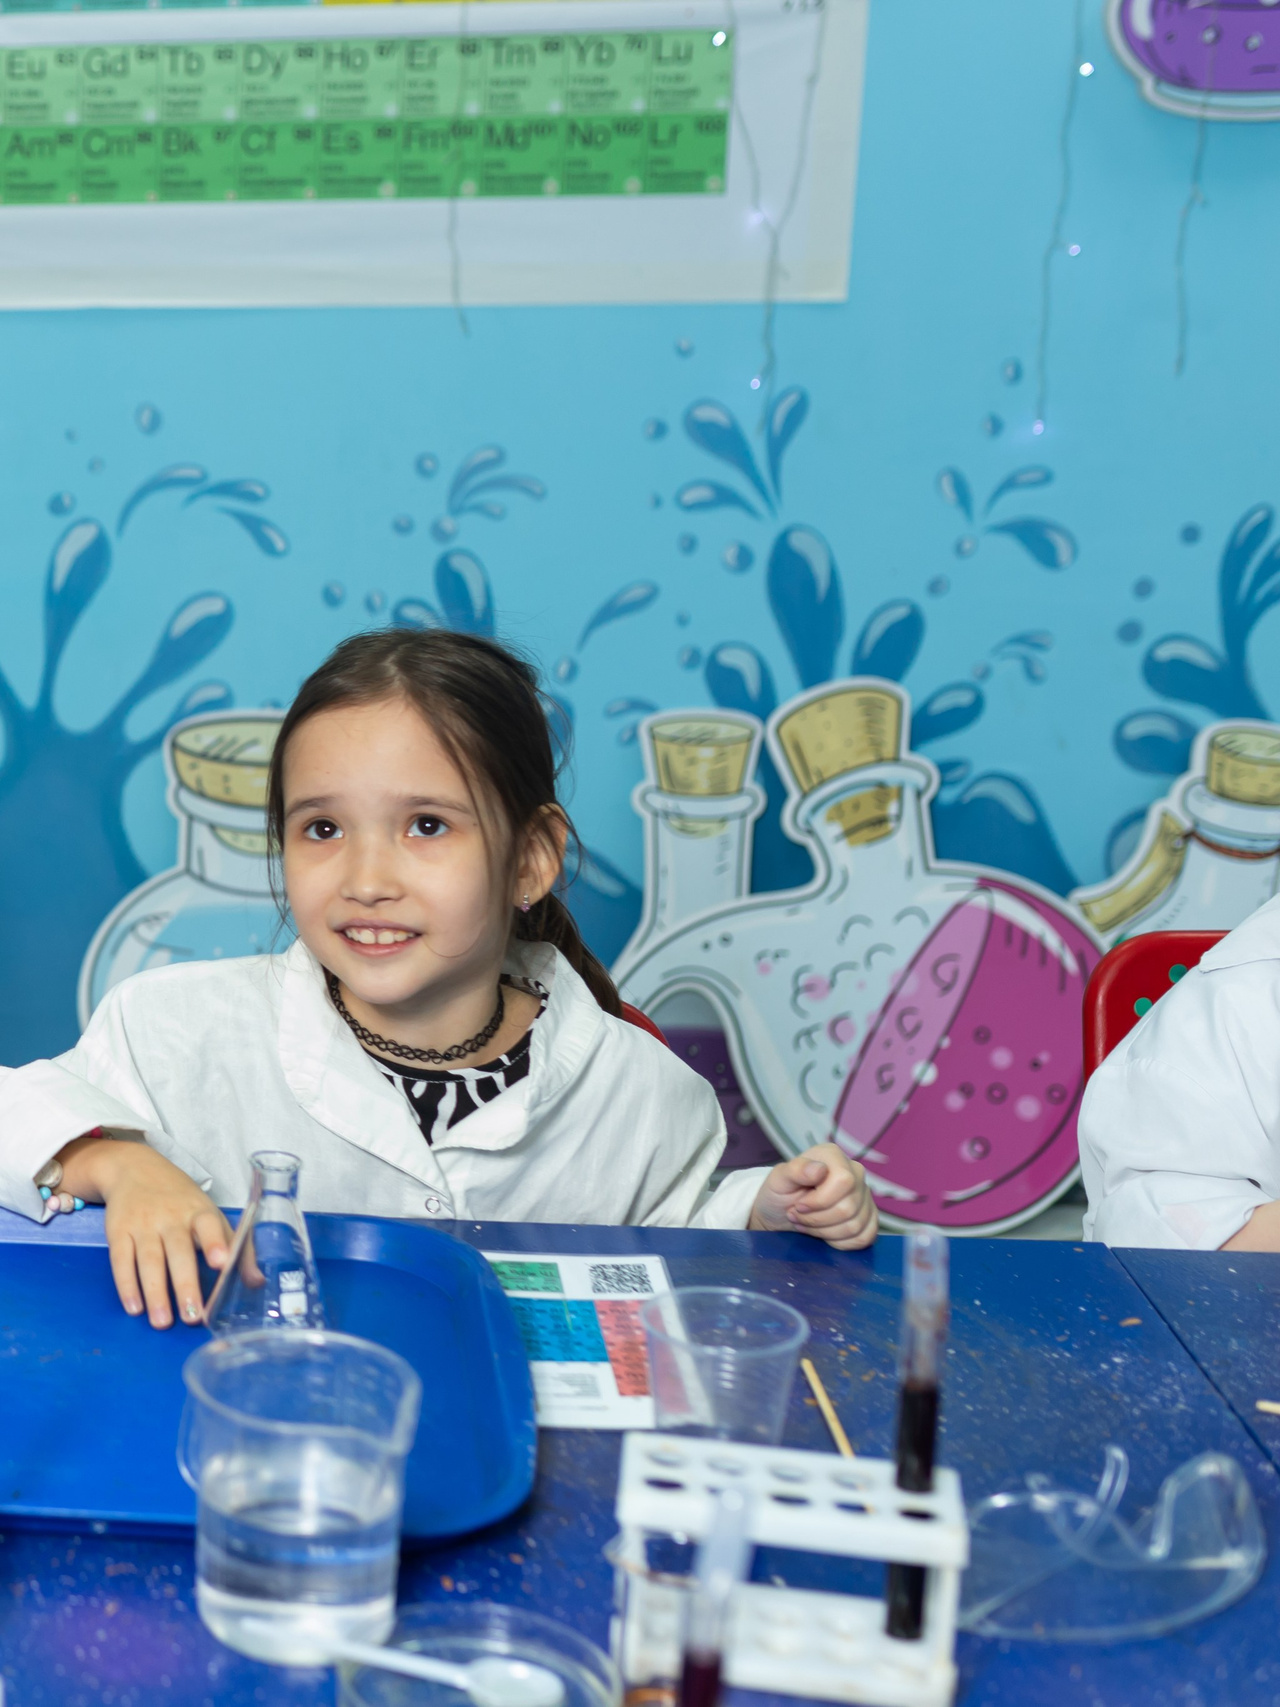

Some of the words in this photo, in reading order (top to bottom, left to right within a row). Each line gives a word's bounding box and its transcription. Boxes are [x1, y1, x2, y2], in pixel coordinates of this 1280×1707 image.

[7, 51, 47, 80] Eu
[84, 48, 130, 78] Gd
[164, 46, 205, 76] Tb
[243, 44, 289, 80] Dy
[323, 42, 369, 72] Ho
[406, 41, 439, 69] Er
[488, 39, 536, 66] Tm
[570, 36, 615, 68] Yb
[652, 35, 693, 65] Lu
[6, 132, 56, 158] Am
[83, 129, 135, 158] Cm
[163, 128, 200, 156] Bk
[241, 125, 277, 156] Cf
[322, 124, 363, 154] Es
[403, 122, 449, 149] Fm
[486, 121, 531, 149] Md
[567, 120, 611, 150] No
[649, 119, 682, 148] Lr
